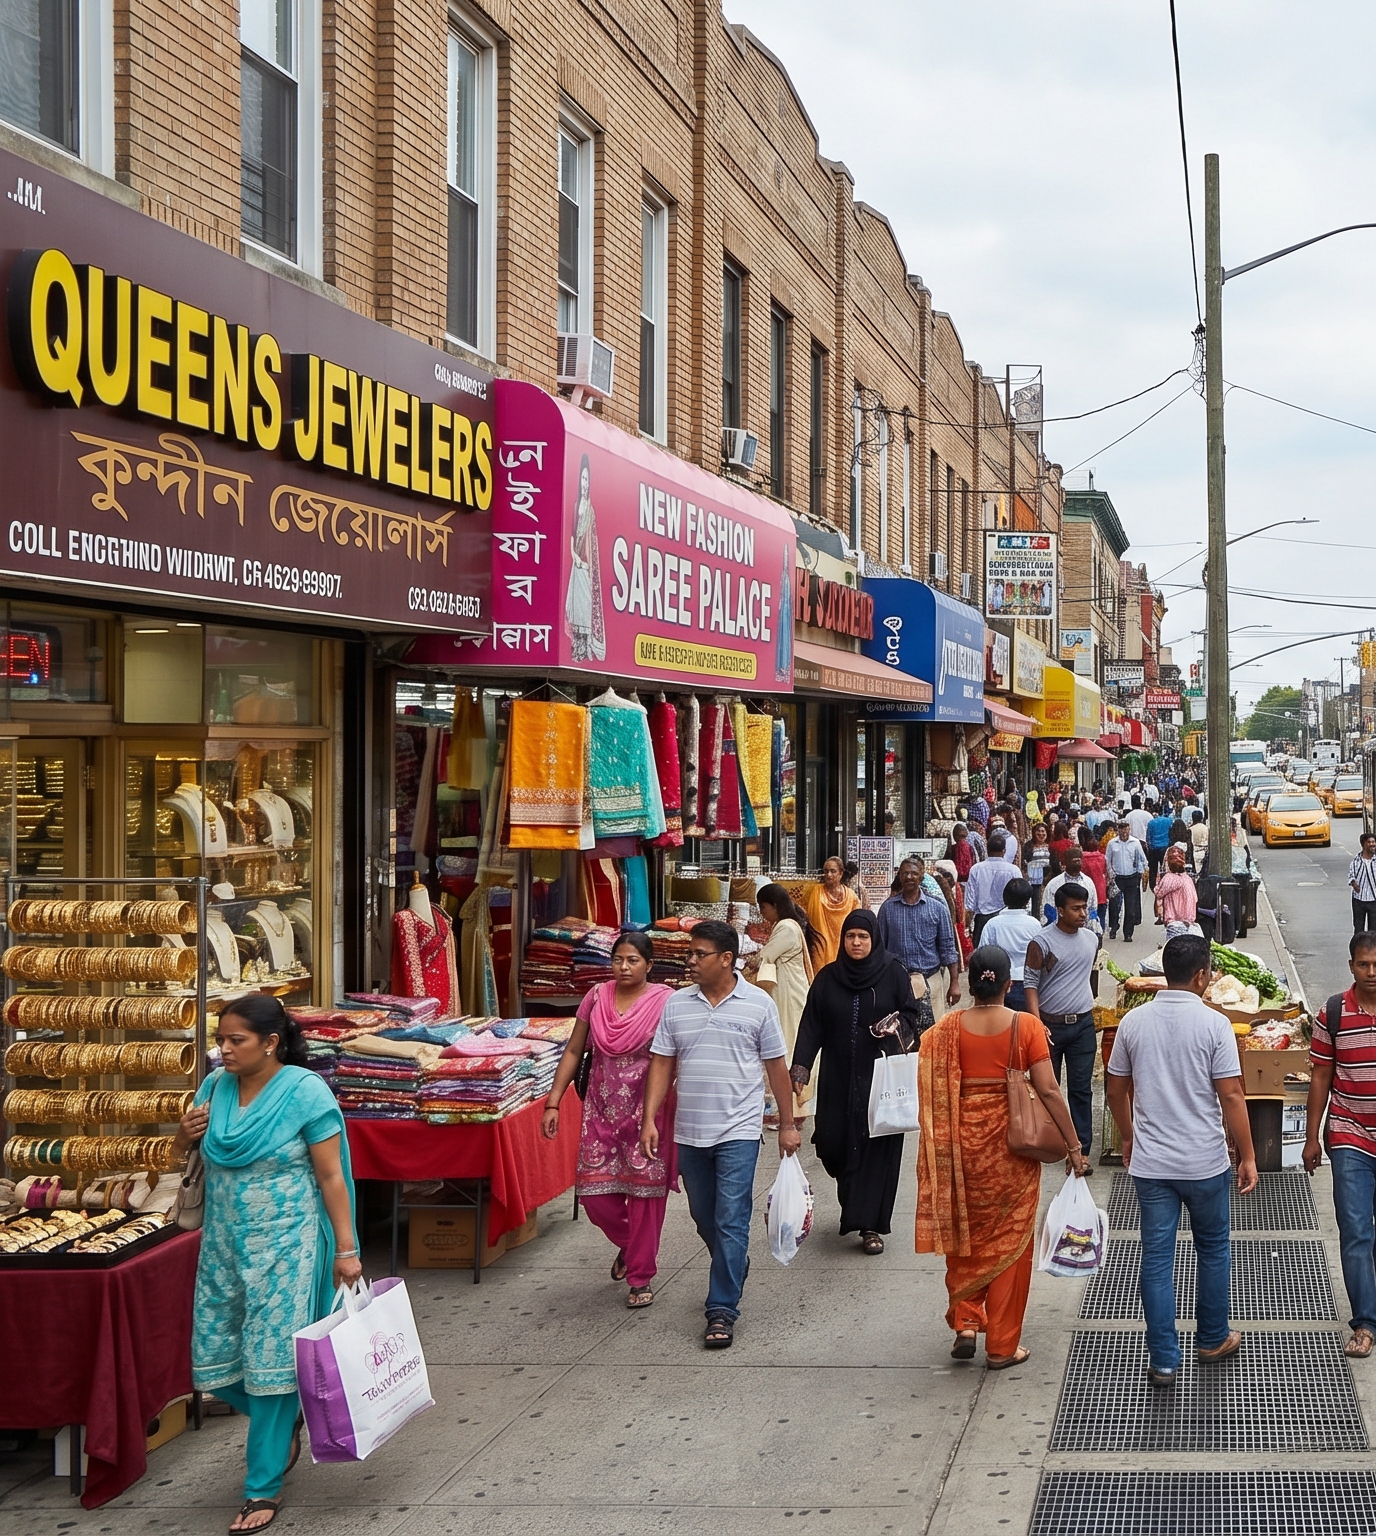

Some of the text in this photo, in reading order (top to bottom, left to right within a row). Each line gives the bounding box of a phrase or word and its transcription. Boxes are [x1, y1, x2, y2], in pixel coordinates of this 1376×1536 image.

[29, 248, 493, 511] QUEENS JEWELERS
[9, 520, 62, 558] COLL
[638, 482, 755, 568] NEW FASHION
[611, 536, 771, 642] SAREE PALACE
